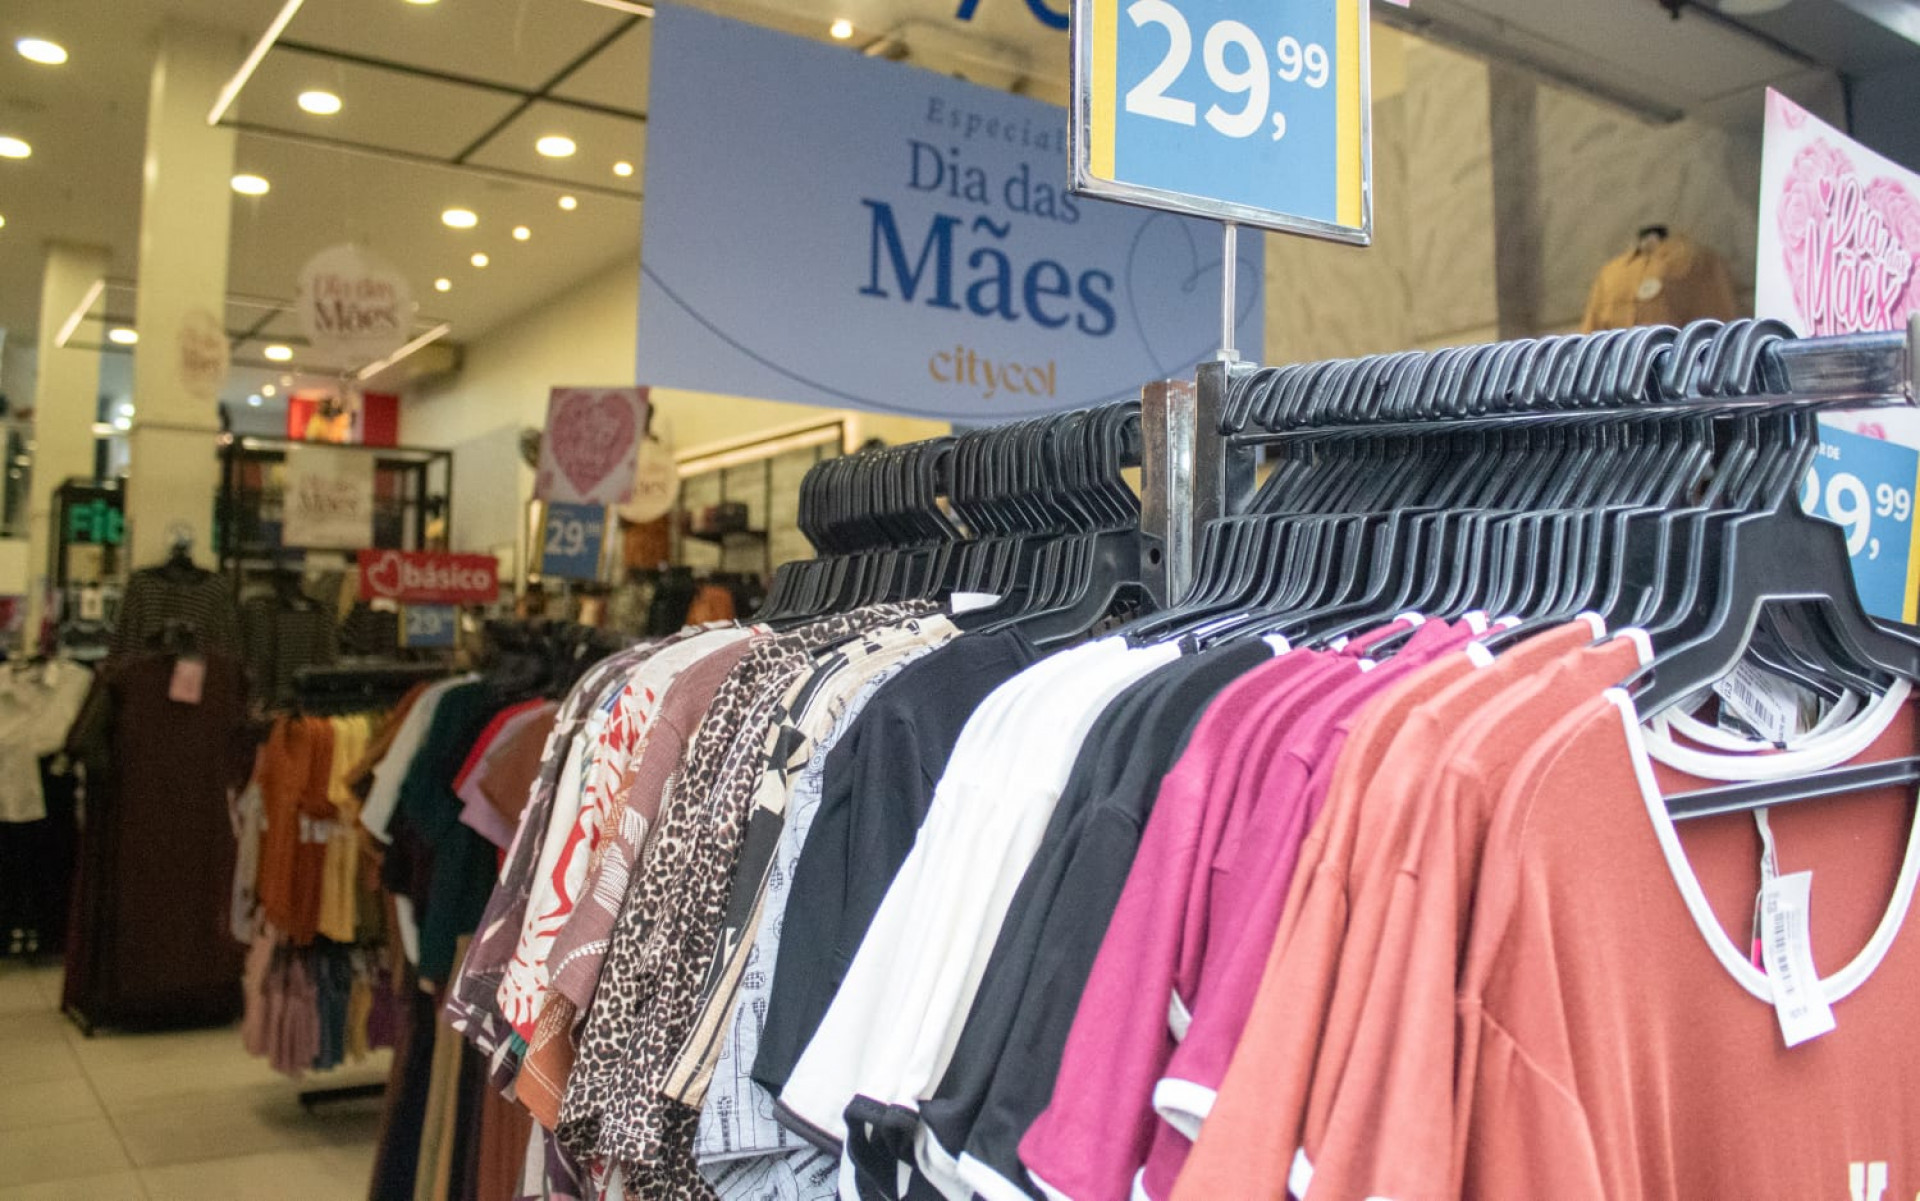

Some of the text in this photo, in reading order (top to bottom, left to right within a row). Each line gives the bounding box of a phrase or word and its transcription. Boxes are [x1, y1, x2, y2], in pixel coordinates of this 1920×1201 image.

[926, 96, 1066, 154] Especial
[907, 138, 1081, 225] Dia das
[858, 197, 1118, 338] Mães
[929, 344, 1056, 399] citycol
[403, 560, 492, 591] básico
